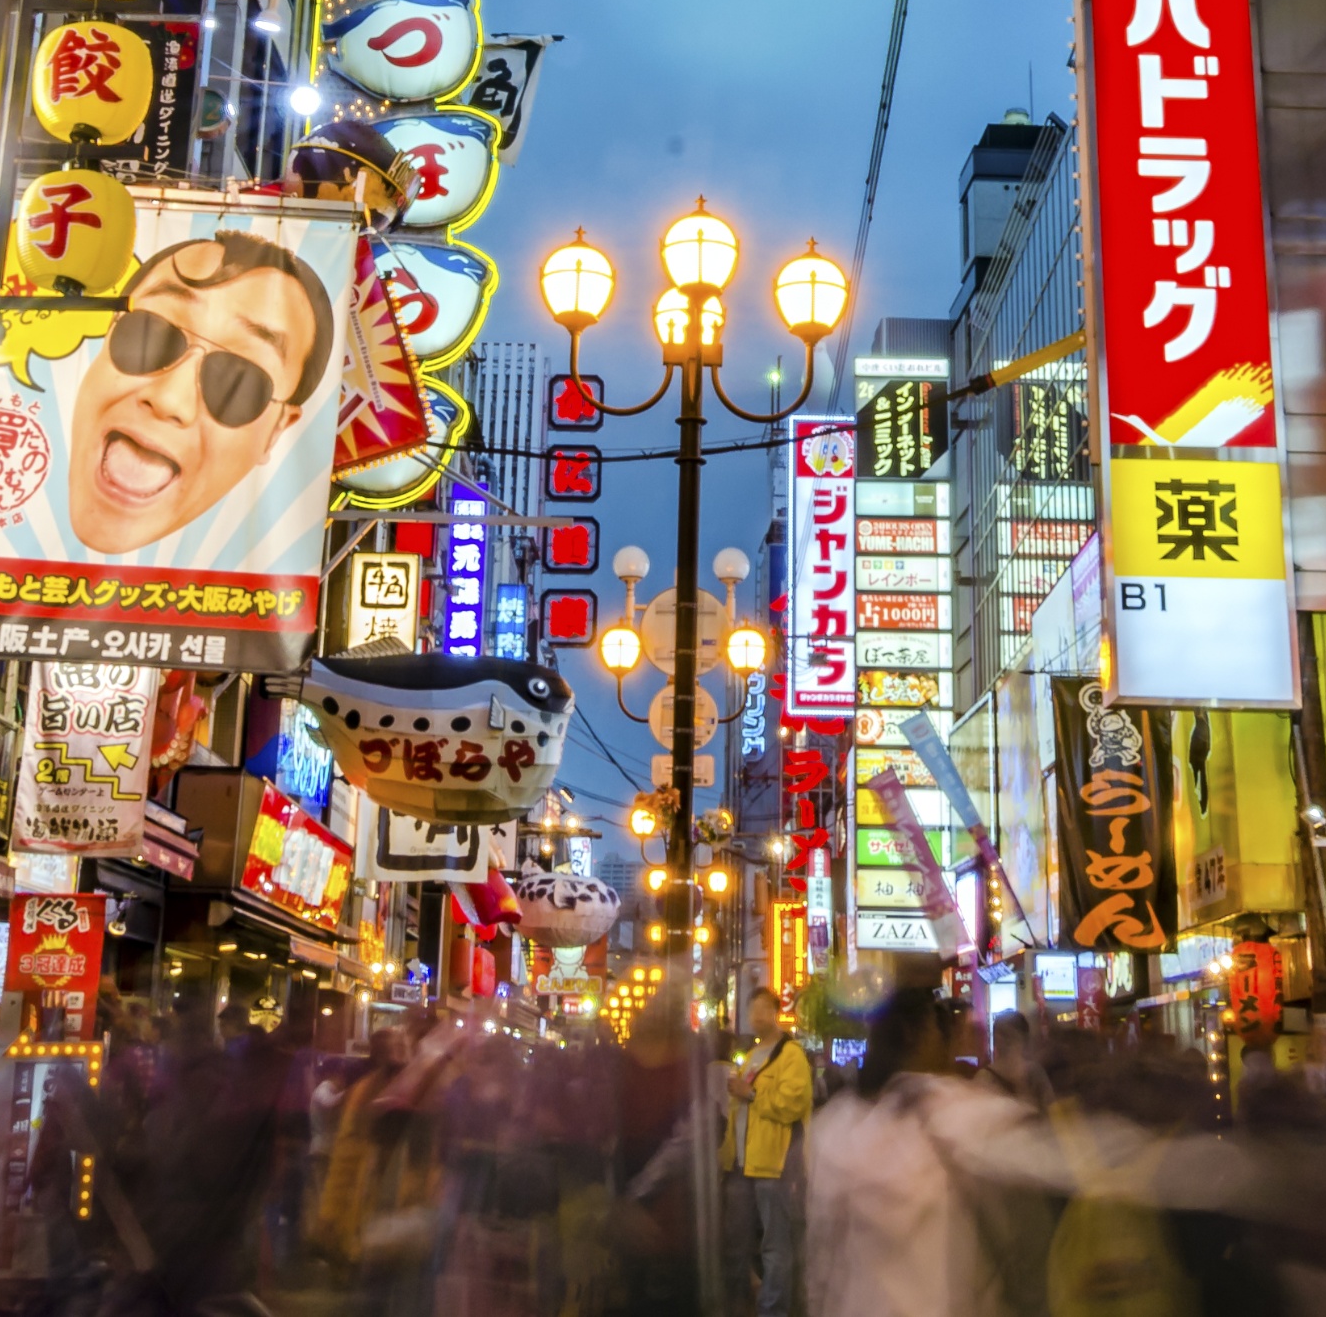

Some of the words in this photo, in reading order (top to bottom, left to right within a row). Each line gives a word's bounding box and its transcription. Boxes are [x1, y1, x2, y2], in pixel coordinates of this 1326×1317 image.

[858, 381, 875, 399] 2F
[1155, 479, 1240, 562] 薬
[810, 485, 848, 687] ジャンカラ
[868, 573, 932, 588] レインボー
[1121, 583, 1169, 612] B1
[179, 633, 228, 664] 선물
[41, 693, 145, 733] 旨い店
[359, 738, 536, 783] づぼらや
[1074, 767, 1167, 949] らーめん
[872, 922, 928, 940] ZAZA
[1239, 953, 1262, 1033] ラーメン
